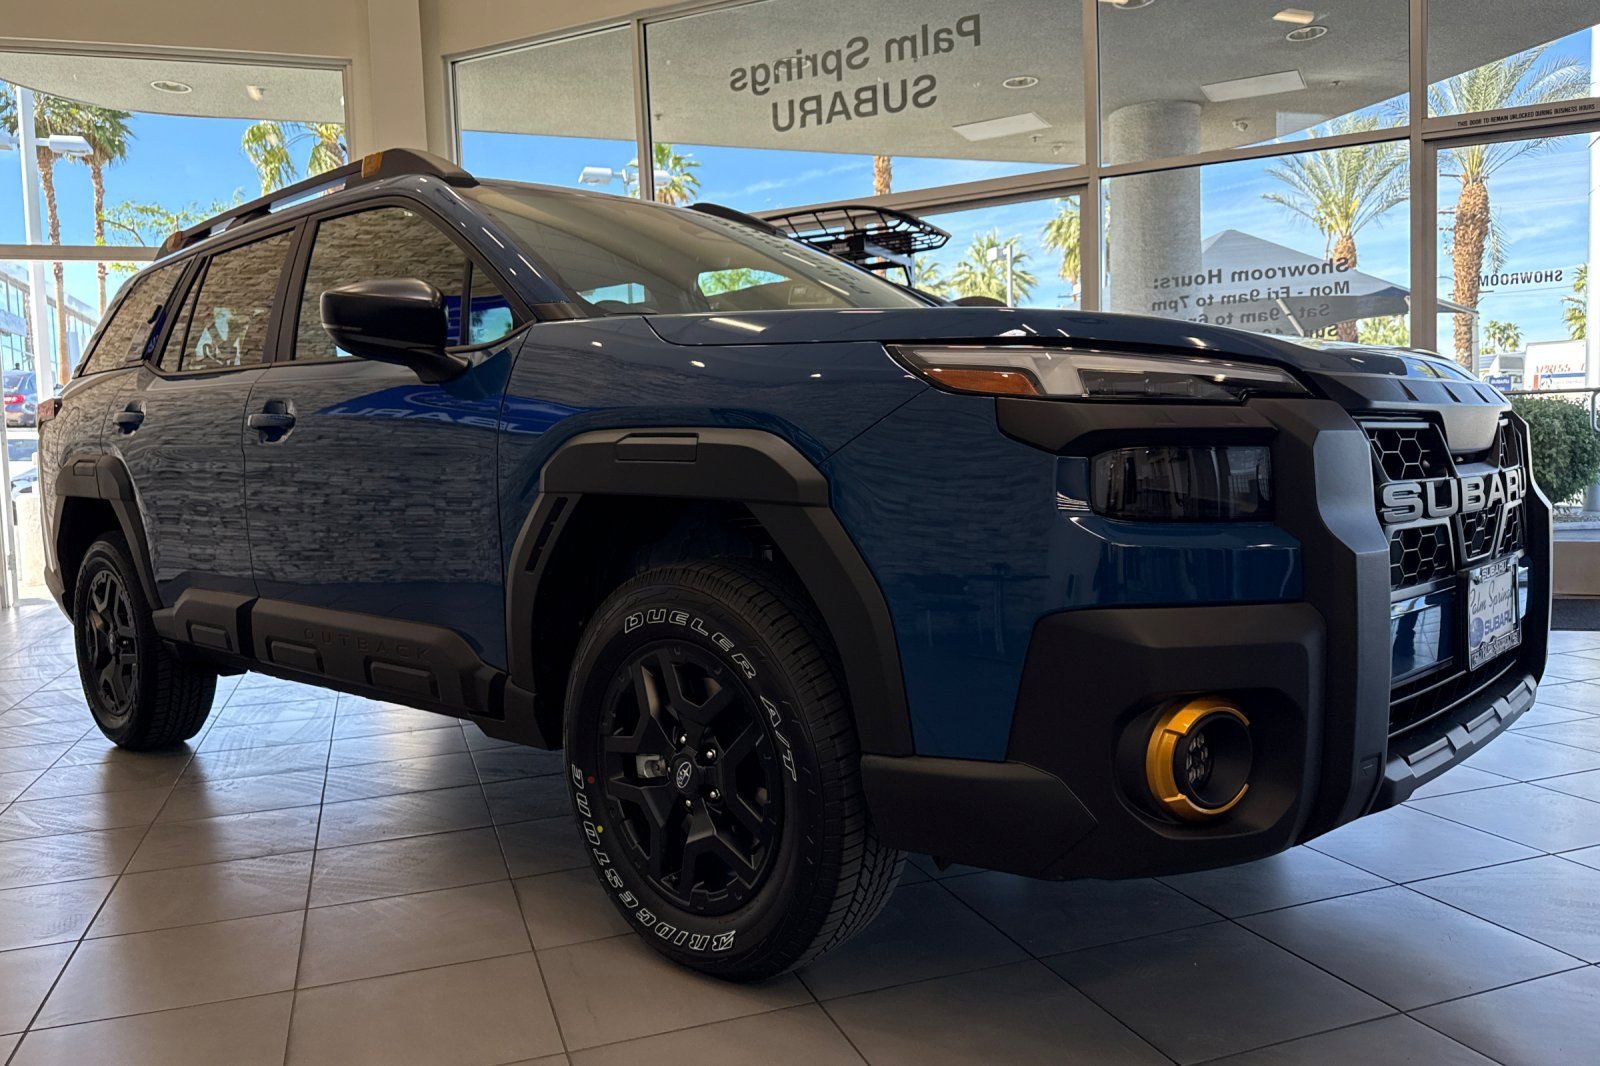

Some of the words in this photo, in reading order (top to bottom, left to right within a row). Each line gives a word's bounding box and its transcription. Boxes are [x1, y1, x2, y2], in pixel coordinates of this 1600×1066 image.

[1491, 115, 1508, 123] REMAIN
[1510, 112, 1534, 121] UNLOCKED
[1535, 109, 1552, 117] DURING
[1554, 105, 1578, 114] BUSINESS
[1579, 103, 1595, 111] HOURS
[1382, 466, 1527, 524] SUBARU
[1470, 588, 1486, 615] Palm
[303, 627, 431, 660] OUTBACK
[624, 608, 756, 679] DUELER
[760, 695, 797, 782] A/T
[571, 763, 736, 952] BRIDGESTONE
